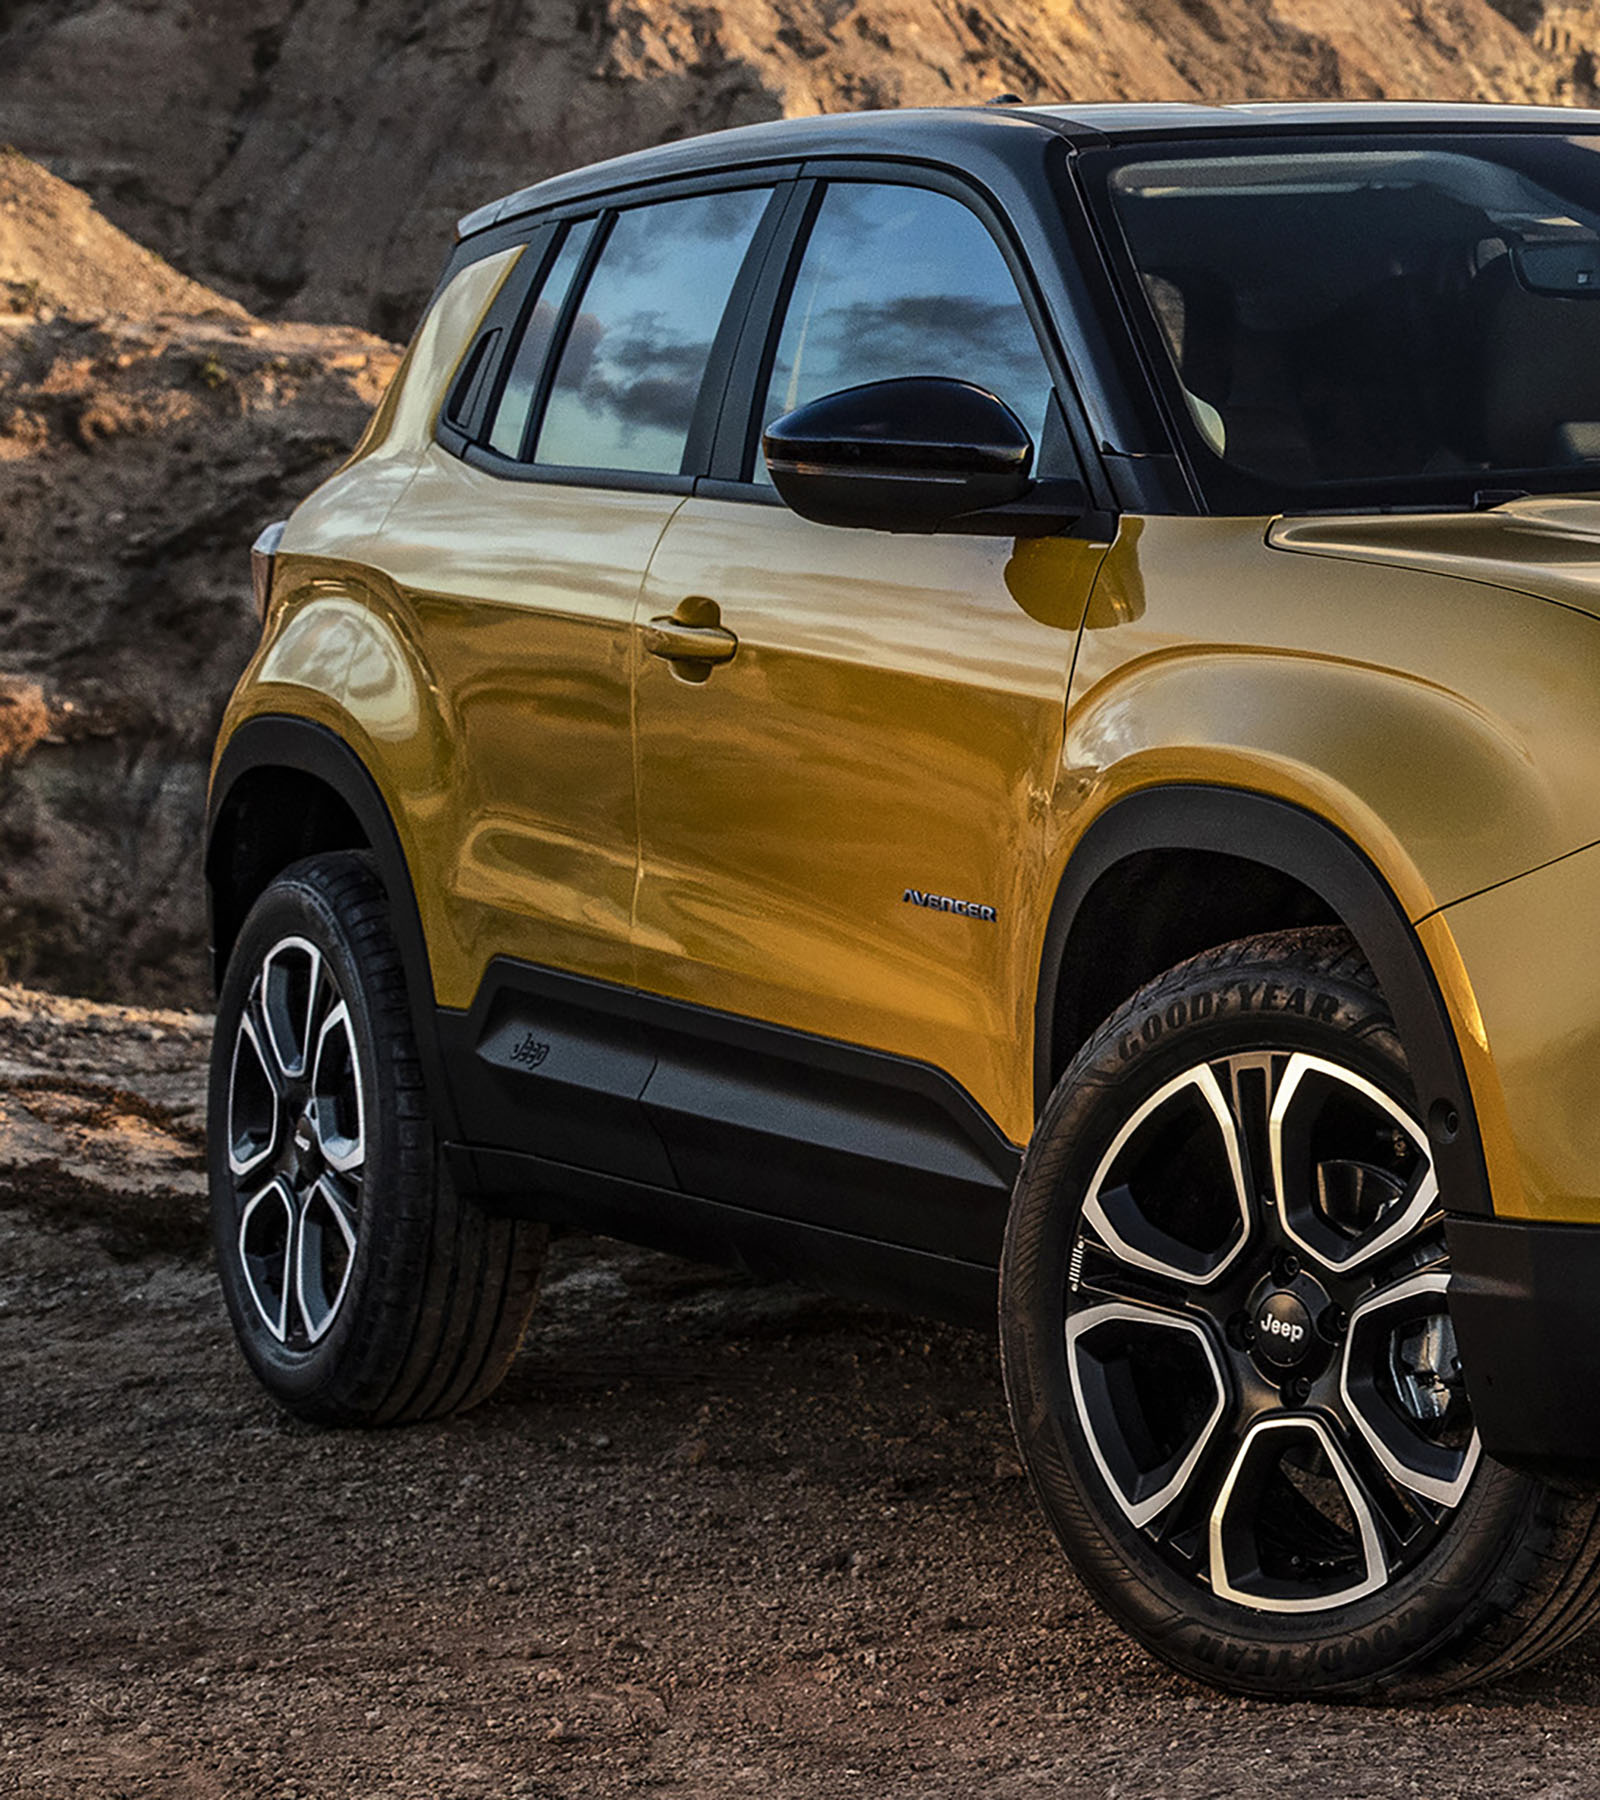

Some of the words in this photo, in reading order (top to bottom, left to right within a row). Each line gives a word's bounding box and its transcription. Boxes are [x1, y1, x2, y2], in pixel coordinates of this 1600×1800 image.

[902, 888, 997, 923] AVENGER
[510, 1032, 550, 1070] Jeep
[1260, 1313, 1304, 1343] Jeep
